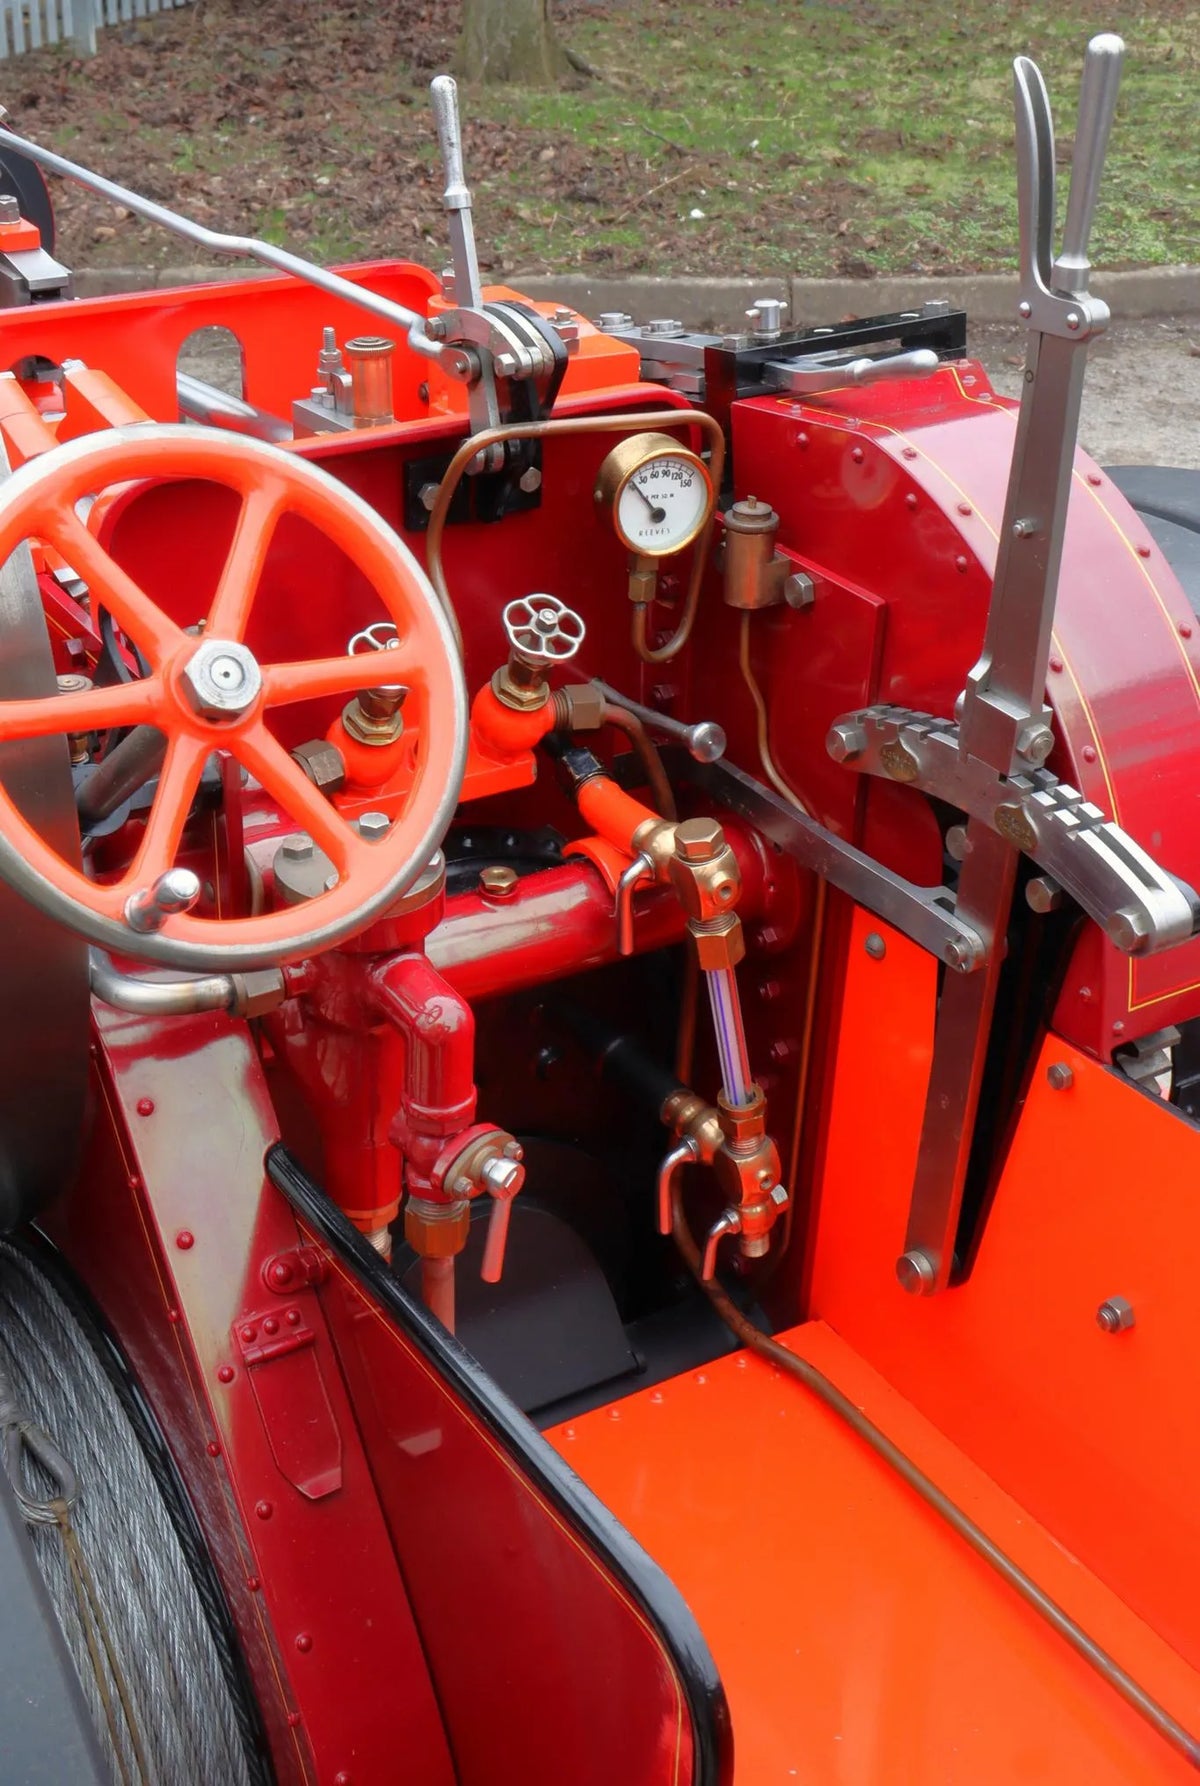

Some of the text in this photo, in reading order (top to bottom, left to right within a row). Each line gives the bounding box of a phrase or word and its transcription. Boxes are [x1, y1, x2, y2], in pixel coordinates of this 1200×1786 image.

[639, 469, 692, 488] 30 60 90 120 150
